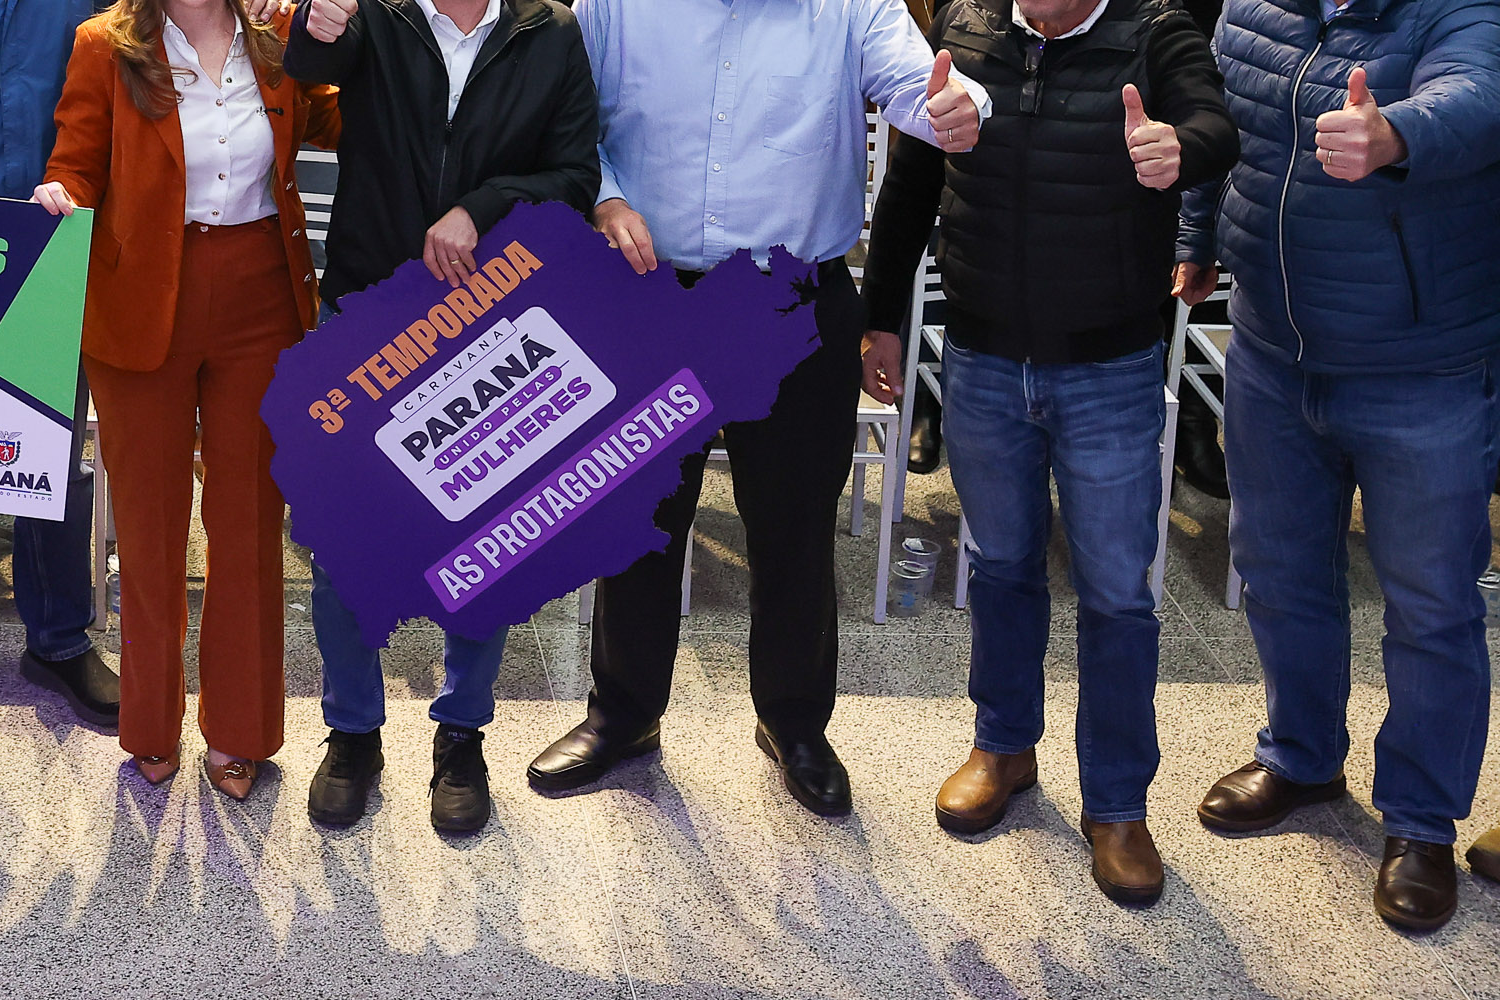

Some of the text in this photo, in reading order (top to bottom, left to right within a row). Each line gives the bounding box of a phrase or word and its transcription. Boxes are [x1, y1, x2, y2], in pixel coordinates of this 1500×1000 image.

[308, 240, 543, 434] 3ª TEMPORADA
[401, 333, 556, 462] PARANÁ
[404, 330, 503, 411] CARAVANA
[439, 372, 554, 464] UNIDO PELAS
[439, 376, 592, 501] MULHERES
[437, 383, 700, 600] AS PROTAGONISTAS
